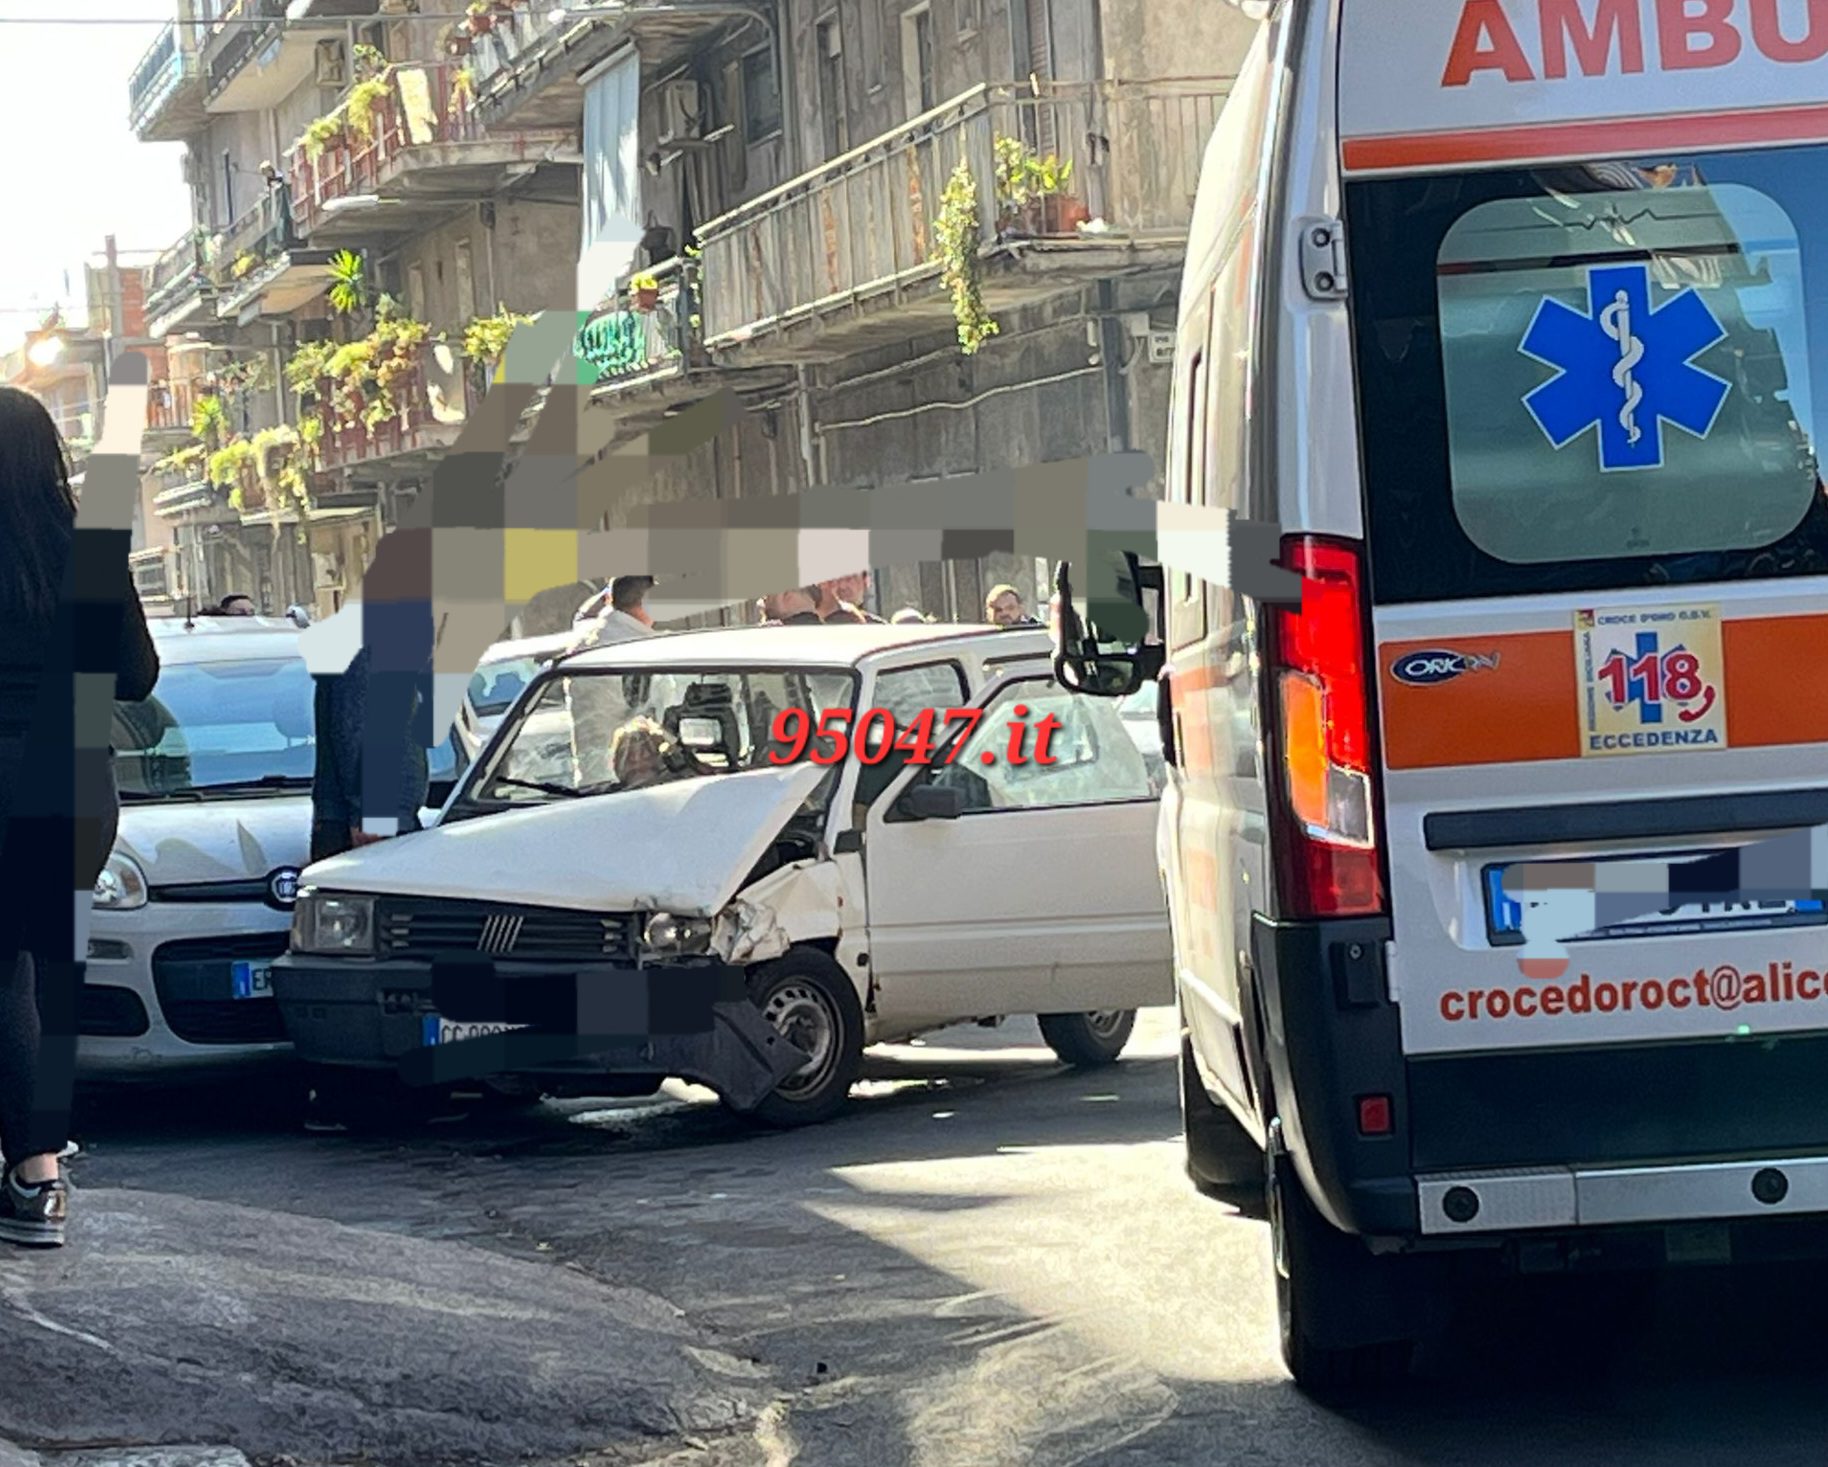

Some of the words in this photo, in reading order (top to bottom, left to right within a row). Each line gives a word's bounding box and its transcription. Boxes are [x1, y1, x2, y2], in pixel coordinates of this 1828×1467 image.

[1441, 0, 1828, 87] AMBU
[1597, 652, 1702, 704] 118
[1589, 728, 1718, 750] ECCEDENZA
[1439, 961, 1828, 1022] crocedoroct@alic
